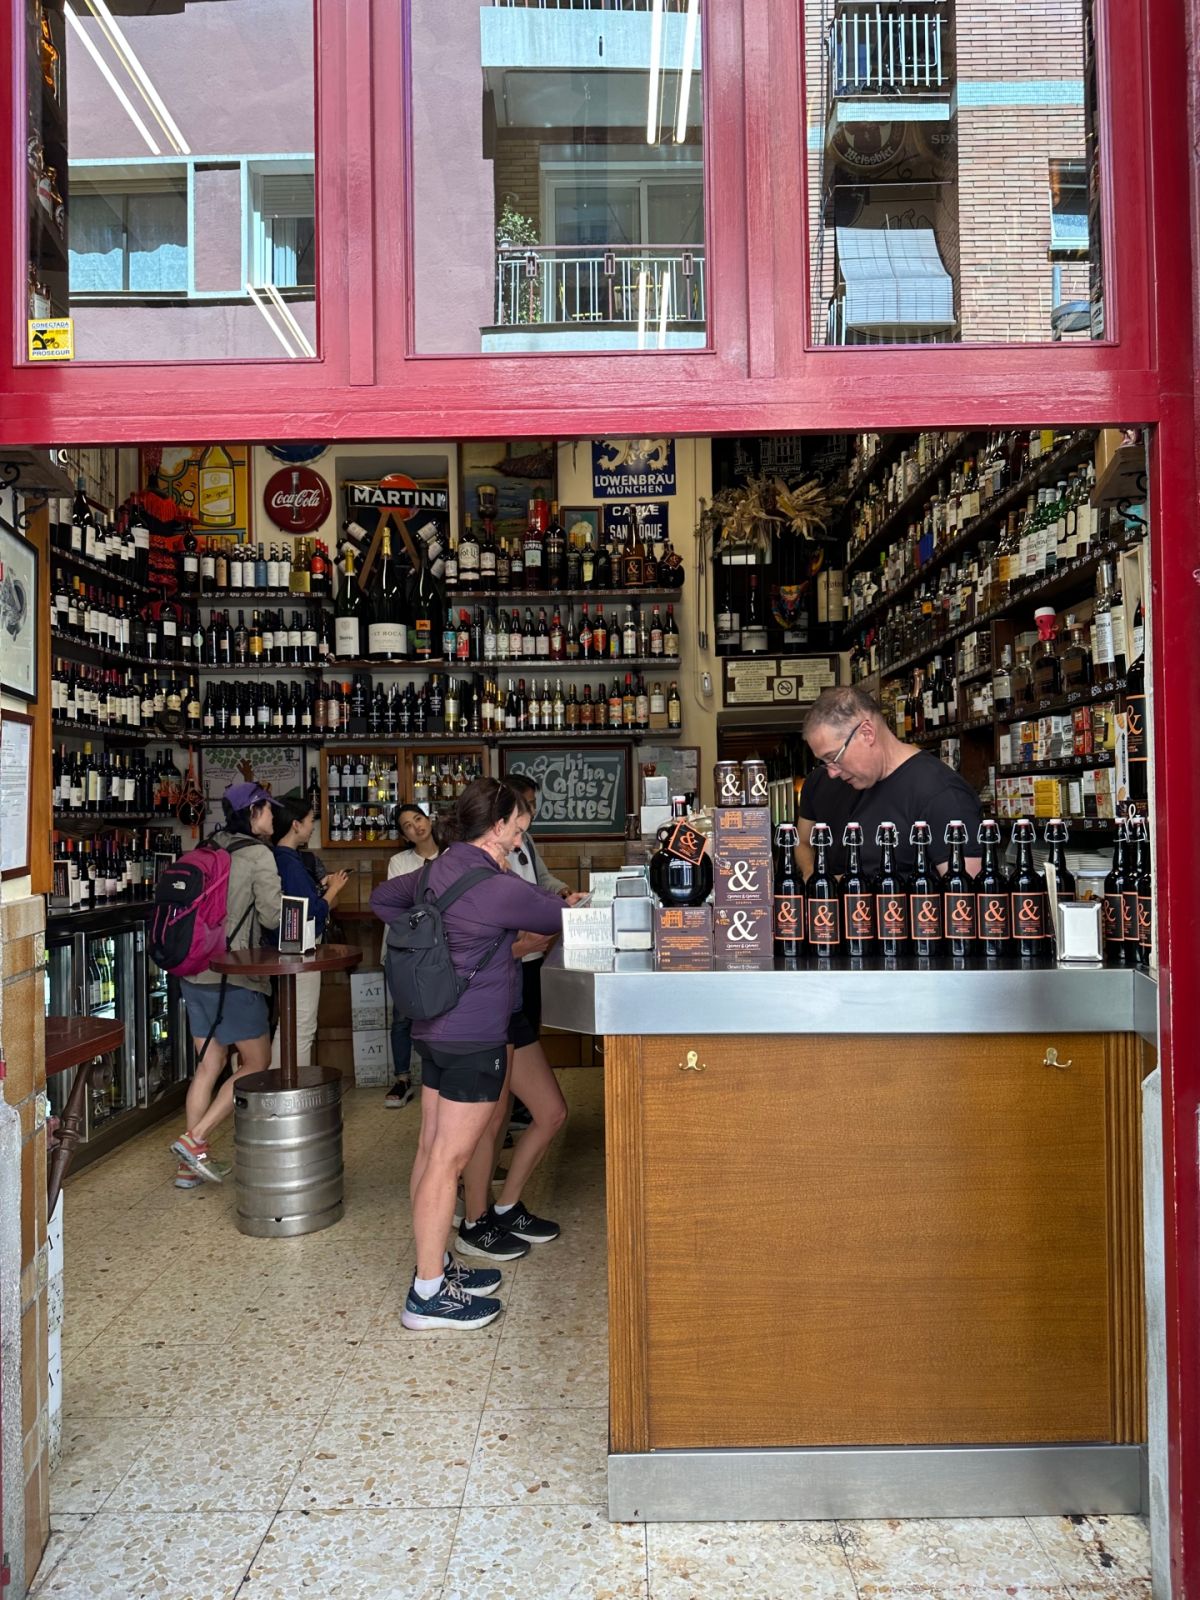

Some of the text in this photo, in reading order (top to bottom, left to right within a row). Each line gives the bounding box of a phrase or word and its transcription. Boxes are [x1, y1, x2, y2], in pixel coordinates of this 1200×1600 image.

[844, 146, 894, 165] Weissbier
[31, 321, 69, 329] CONECTADA
[32, 349, 70, 357] PROSEGUR
[594, 473, 674, 487] LÖWENBRÄU
[606, 484, 663, 495] MÜNCHEN
[354, 488, 446, 507] MARTINI
[609, 523, 628, 540] SAN
[627, 560, 639, 575] &
[583, 763, 605, 781] ha
[721, 773, 741, 797] &
[750, 773, 768, 797] &
[679, 831, 699, 850] &
[727, 860, 760, 892] &
[777, 901, 798, 923] &
[814, 905, 835, 927] &
[852, 900, 872, 922] &
[883, 900, 904, 922] &
[917, 900, 938, 922] &
[951, 899, 973, 921] &
[984, 900, 1006, 922] &
[1018, 899, 1041, 921] &
[727, 910, 759, 942] &
